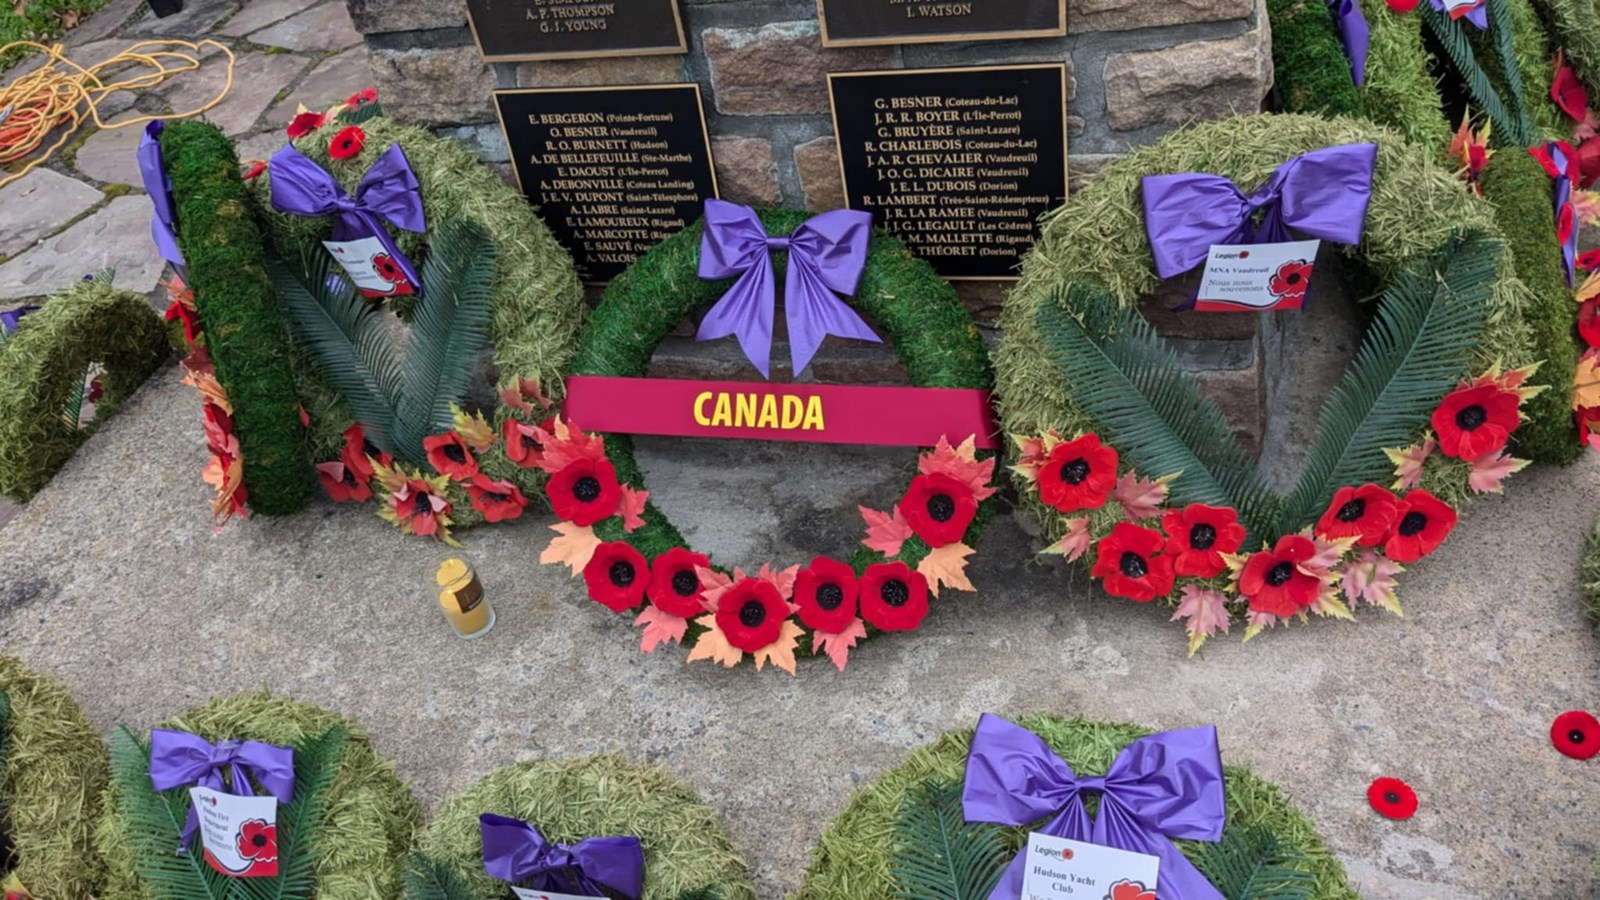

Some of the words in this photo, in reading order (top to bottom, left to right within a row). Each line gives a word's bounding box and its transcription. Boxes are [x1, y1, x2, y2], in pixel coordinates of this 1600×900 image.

[526, 8, 538, 20] A.
[539, 8, 550, 19] P.
[551, 4, 615, 18] THOMPSON
[919, 3, 972, 17] WATSON
[540, 21, 553, 33] G.
[565, 18, 607, 32] YOUNG
[874, 98, 888, 109] G.
[891, 96, 942, 109] BESNER
[945, 95, 1018, 108] (Coteau-du-Lac)
[528, 114, 539, 124] E.
[540, 112, 605, 124] BERGERON
[606, 112, 674, 124] (Pointe-Fortune)
[874, 112, 883, 126] J.
[885, 112, 898, 123] R.
[900, 112, 913, 123] R.
[916, 111, 960, 122] BOYER
[550, 127, 562, 137] O.
[564, 127, 609, 137] BESNER
[610, 126, 658, 137] (Vaudreuil)
[878, 127, 892, 138] G.
[894, 124, 954, 137] BRUYÈRE
[956, 125, 1020, 136] (Saint-Lazare)
[545, 141, 557, 151] R.
[559, 141, 572, 150] O.
[572, 140, 628, 150] BURNETT
[630, 140, 669, 151] (Hudson)
[864, 142, 877, 152] R.
[879, 140, 962, 152] CHARLEBOIS
[965, 139, 1037, 151] (Coteau-du-Lac)
[531, 154, 541, 164] A.
[543, 154, 559, 164] DE
[560, 153, 640, 164] BELLEFEUILLE
[641, 153, 692, 164] (Ste-Marthe)
[867, 155, 875, 168] J.
[877, 155, 890, 165] A.
[892, 155, 904, 165] R.
[906, 153, 983, 164] CHEVALIER
[985, 153, 1038, 164] (Vaudreuil)
[557, 167, 568, 177] E.
[569, 166, 615, 177] DAOUST
[877, 169, 885, 181] J.
[887, 168, 900, 178] O.
[903, 168, 916, 178] G.
[919, 167, 974, 178] DICAIRE
[976, 168, 1029, 178] (Vaudreuil)
[541, 180, 551, 190] A.
[552, 180, 625, 190] DEBONVILLE
[626, 180, 656, 190] (Coteau
[657, 180, 695, 190] Landing)
[890, 182, 898, 194] J.
[900, 182, 911, 192] E.
[913, 182, 924, 192] L.
[927, 181, 976, 192] DUBOIS
[979, 181, 1018, 192] (Dorion)
[550, 193, 560, 202] E.
[561, 193, 573, 202] V.
[575, 192, 624, 202] DUPONT
[863, 195, 875, 206] R.
[877, 195, 937, 205] LAMBERT
[570, 206, 581, 214] A.
[582, 205, 619, 214] LABRE
[621, 206, 675, 215] (Saint-Lazare)
[885, 208, 892, 220] J.
[895, 208, 907, 218] R.
[910, 208, 926, 218] LA
[929, 208, 975, 218] RAMEE
[977, 208, 1028, 218] (Vaudreuil)
[566, 217, 576, 226] E.
[578, 217, 649, 226] LAMOUREUX
[651, 219, 685, 228] (Rigaud)
[894, 221, 900, 232] J.
[902, 221, 915, 231] G.
[918, 221, 975, 231] LEGAULT
[978, 221, 997, 232] (Les
[998, 222, 1032, 231] Cèdres)
[573, 230, 584, 238] A.
[585, 230, 649, 238] MARCOTTE
[908, 234, 923, 243] M.
[925, 234, 993, 243] MALLETTE
[996, 235, 1034, 245] (Rigaud)
[584, 242, 594, 250] E.
[595, 240, 632, 251] SAUVÉ
[918, 245, 976, 256] THÉORET
[979, 248, 1017, 256] (Dorion)
[586, 254, 597, 262] A.
[598, 254, 637, 262] VALOIS
[694, 391, 825, 430] CANADA
[1034, 844, 1061, 857] Legion
[1033, 866, 1067, 880] Hudson
[1070, 873, 1095, 886] Yacht
[1051, 882, 1074, 894] Club
